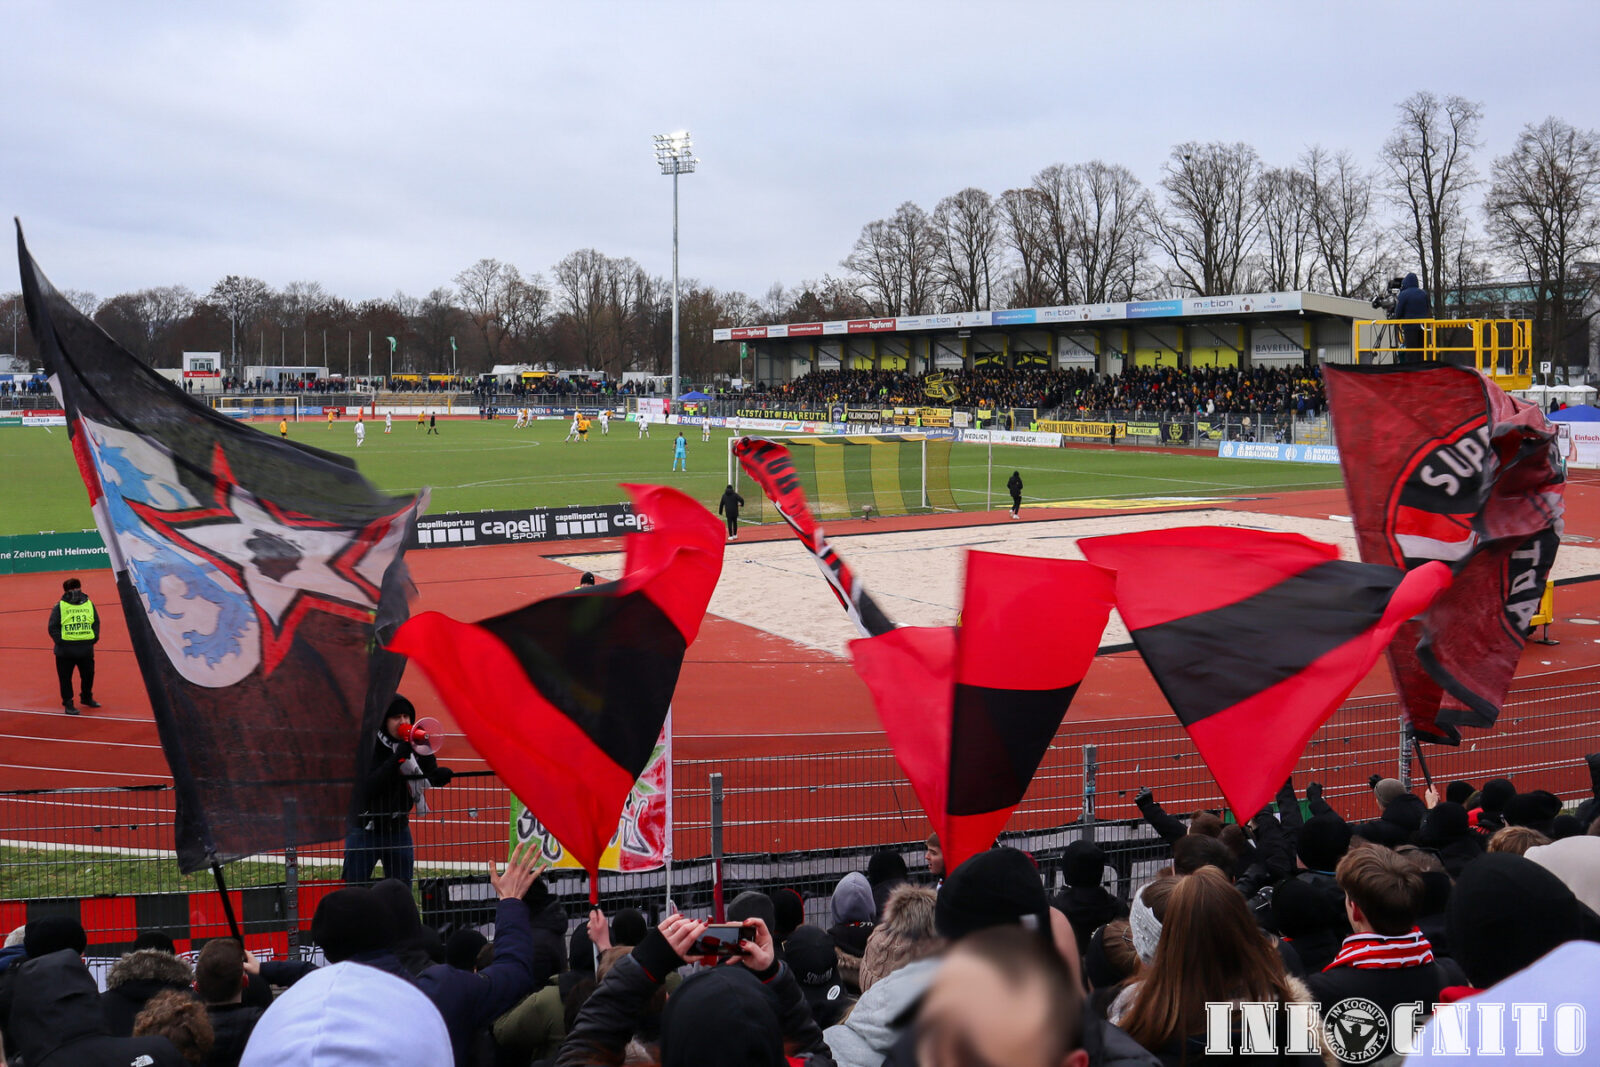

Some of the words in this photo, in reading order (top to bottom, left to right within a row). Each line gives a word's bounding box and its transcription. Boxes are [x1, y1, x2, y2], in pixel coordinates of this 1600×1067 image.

[1542, 363, 1549, 372] P
[852, 424, 866, 435] LIGA
[1010, 435, 1036, 443] WEDLICH
[555, 512, 608, 522] capellisport.eu
[417, 519, 475, 529] capellisport.eu
[480, 514, 547, 539] capelli
[512, 532, 546, 540] SPORT
[13, 549, 46, 560] Zeitung
[48, 548, 63, 557] mit
